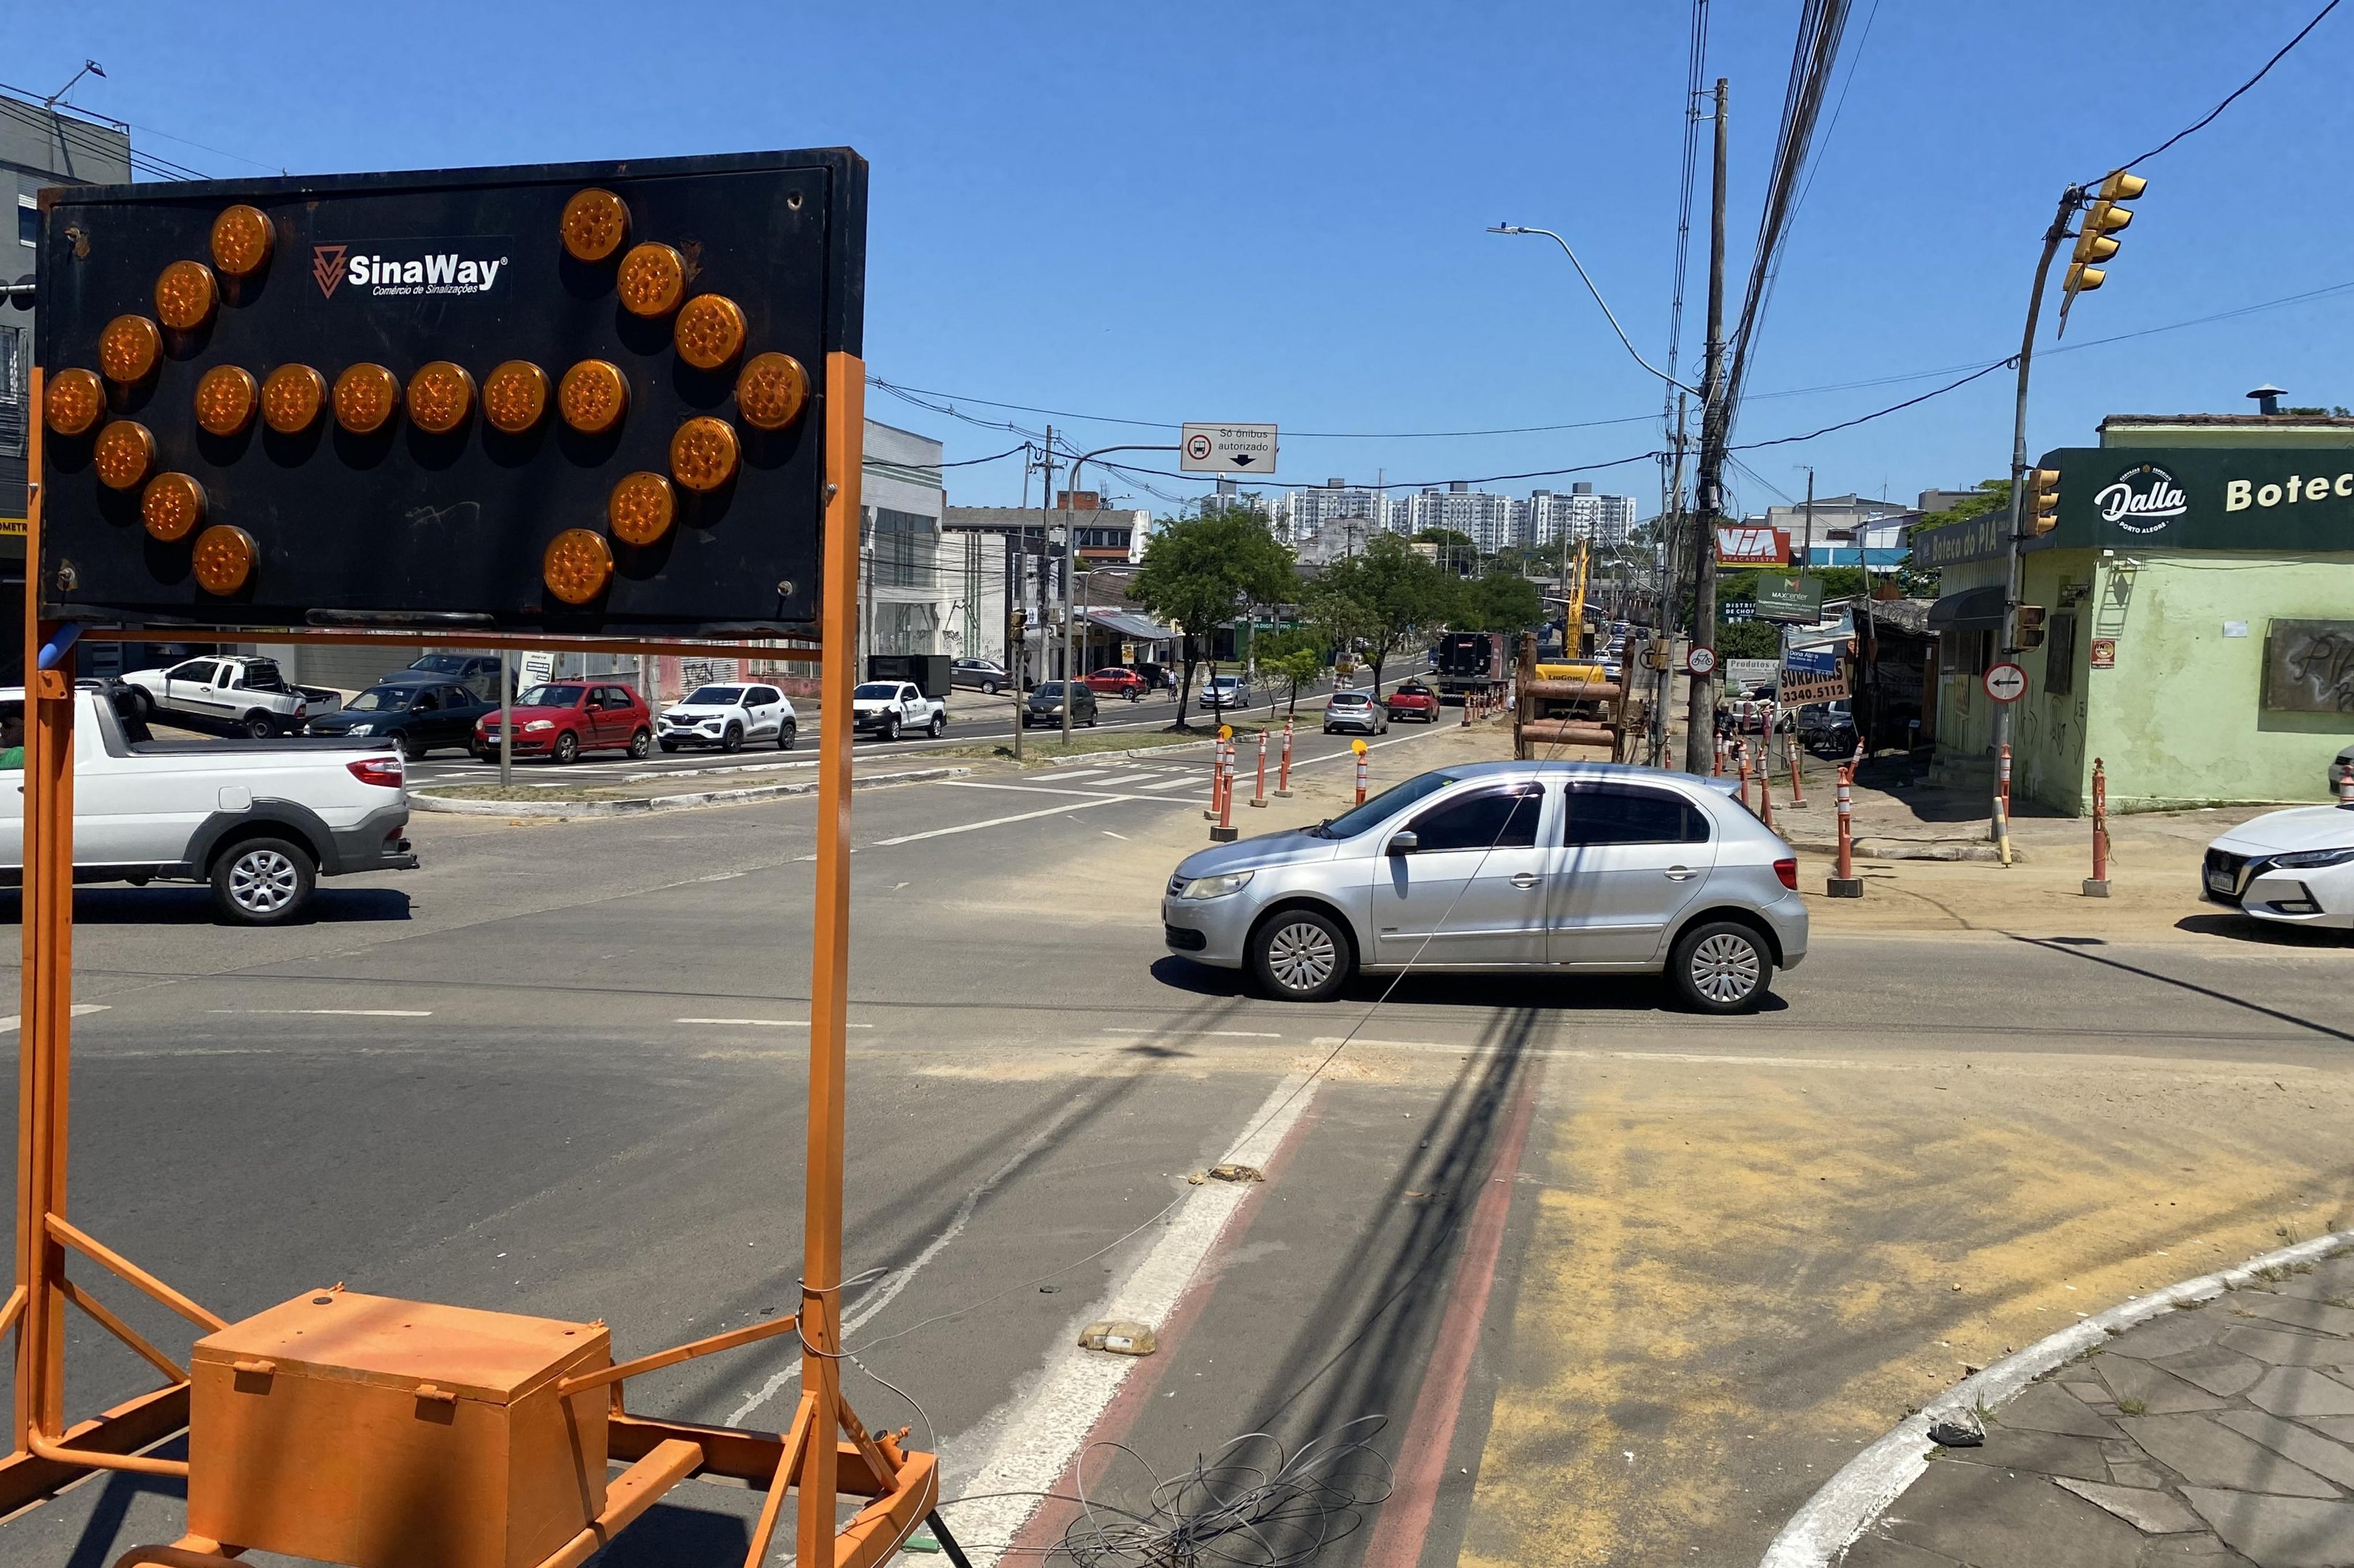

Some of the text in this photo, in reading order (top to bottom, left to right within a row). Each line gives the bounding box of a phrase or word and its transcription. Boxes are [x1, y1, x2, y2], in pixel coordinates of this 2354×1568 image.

[372, 284, 478, 296] Comércio de Sinalizações
[1219, 428, 1268, 438] Só ônibus
[2094, 481, 2187, 521] Dalla
[2119, 521, 2167, 534] PORTO ALEGRE
[1932, 535, 1960, 562] Boteco
[1963, 524, 1975, 556] do
[1978, 518, 1997, 553] PIA
[1783, 685, 1844, 703] 3340.5112
